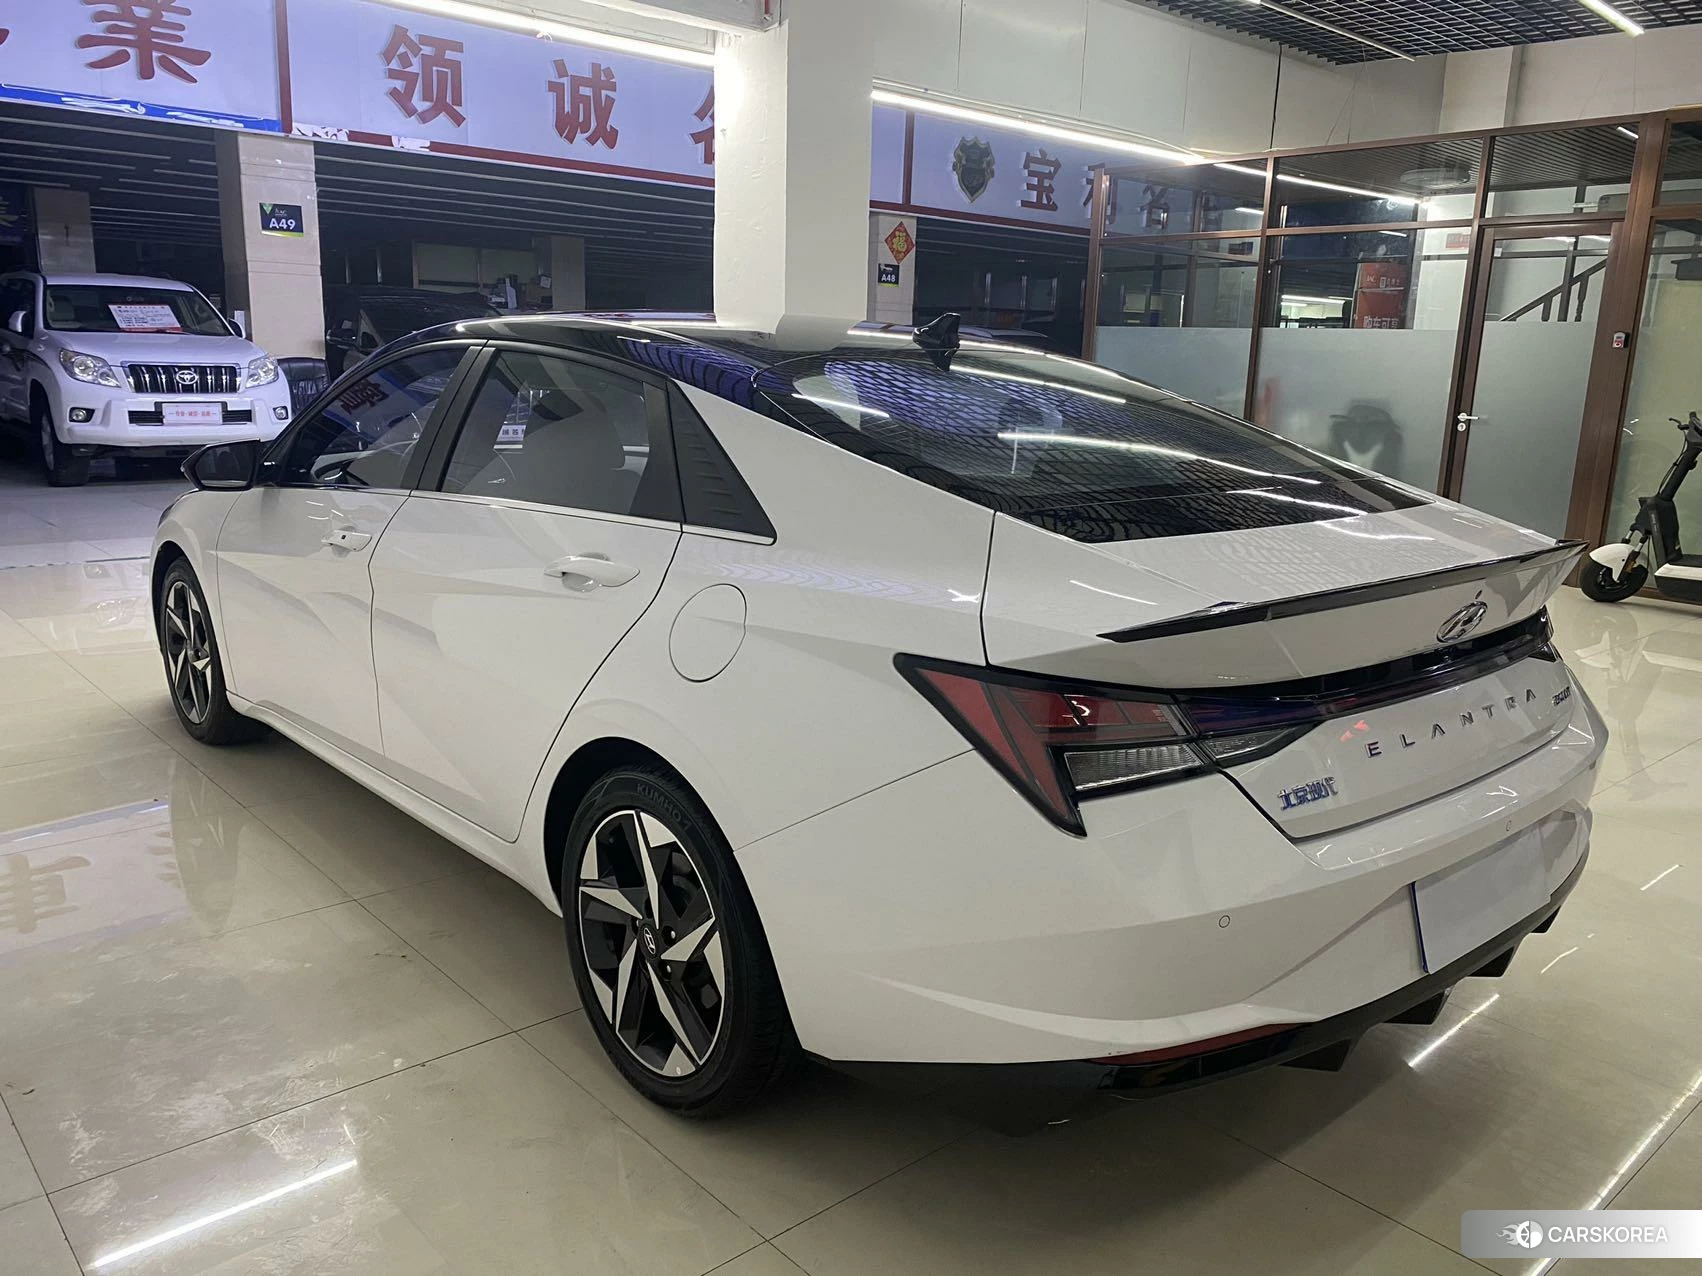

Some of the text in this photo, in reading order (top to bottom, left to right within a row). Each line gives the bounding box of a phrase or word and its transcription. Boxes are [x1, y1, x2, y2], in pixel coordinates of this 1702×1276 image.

[1018, 148, 1222, 230] 宝利名
[269, 218, 296, 230] A49
[881, 273, 896, 282] A48
[1364, 686, 1538, 758] ELANTRA
[636, 783, 682, 822] KUMHO
[1277, 776, 1338, 811] 北京现代
